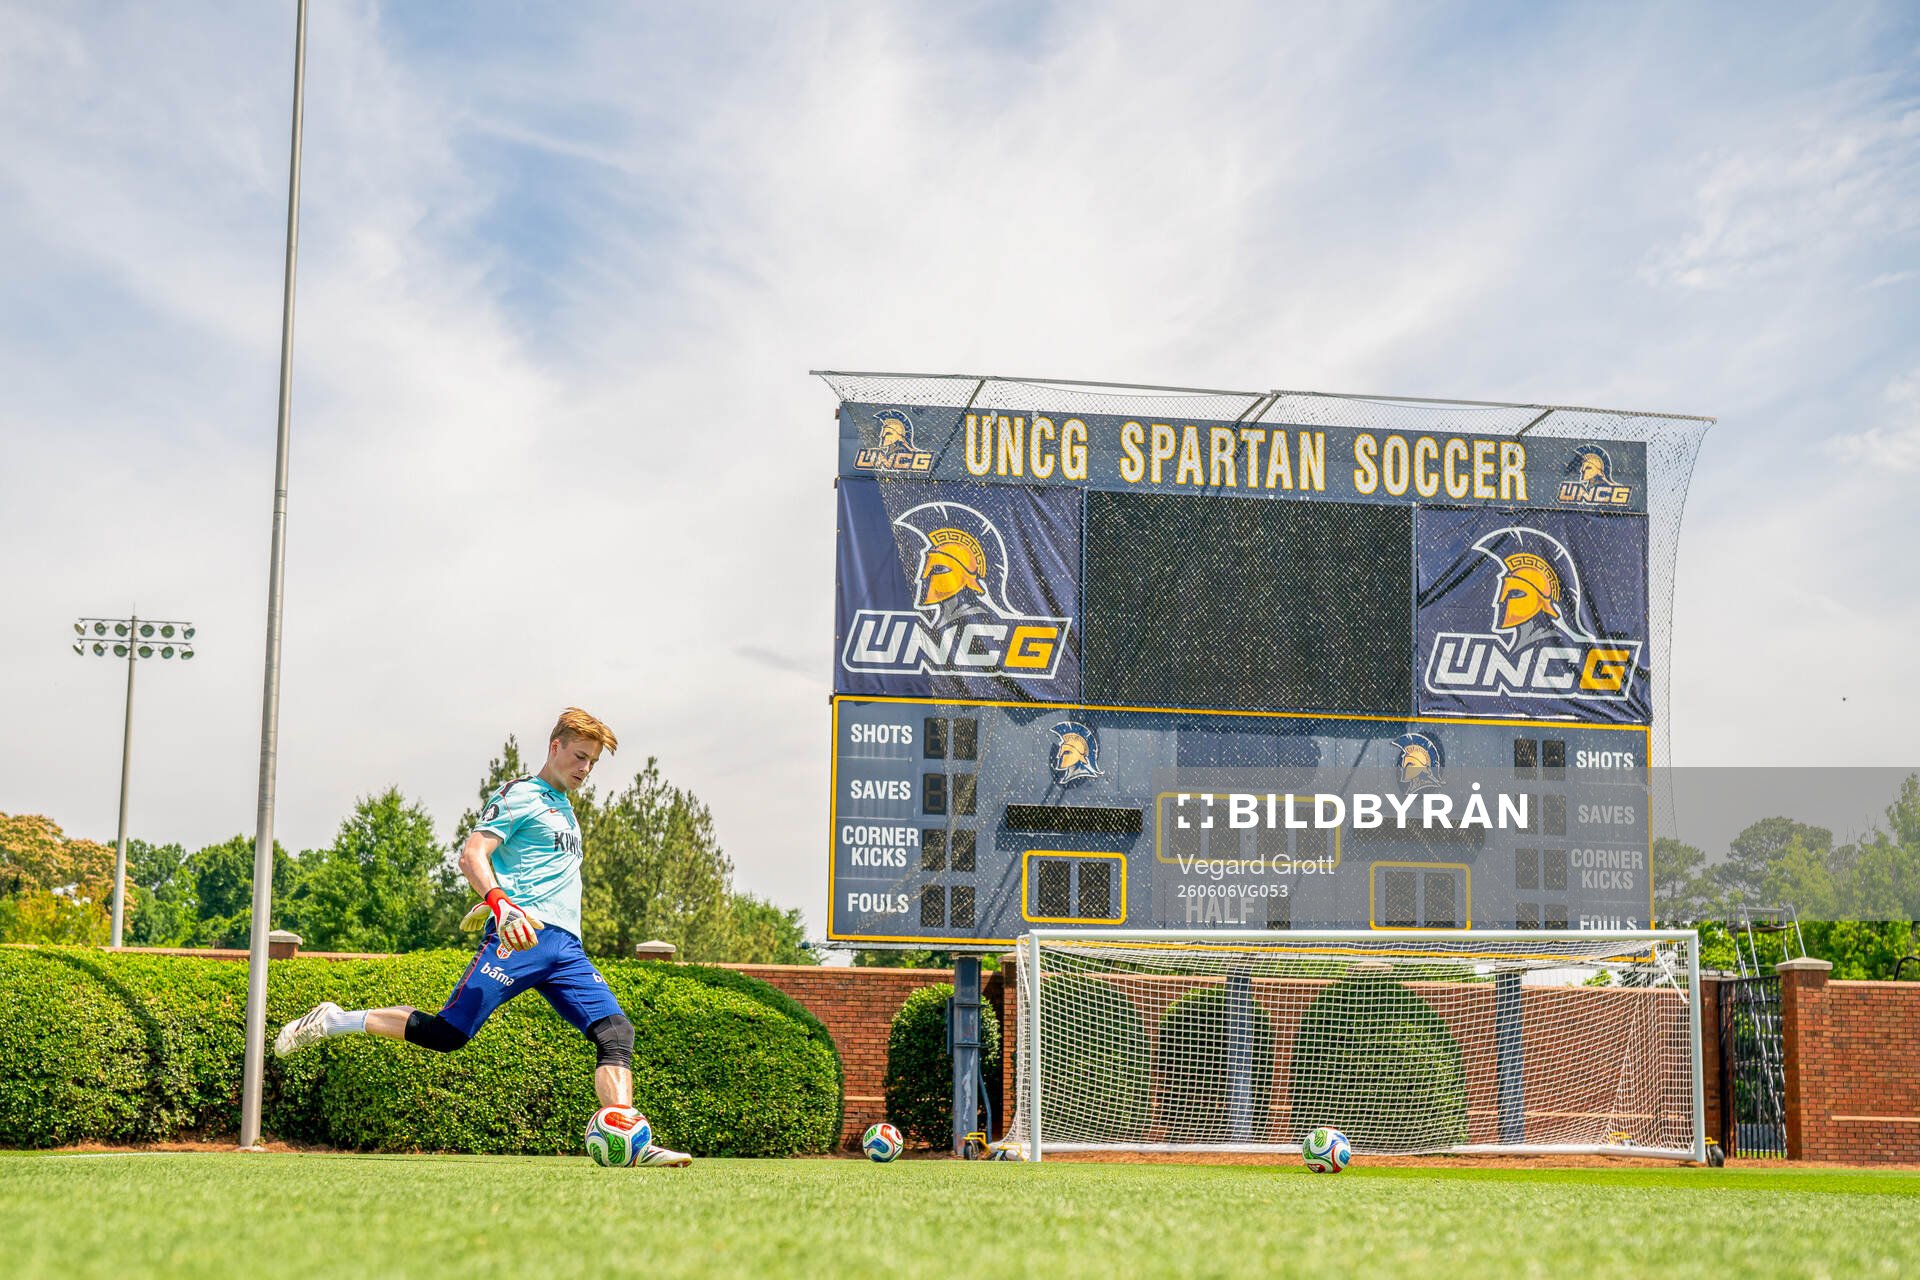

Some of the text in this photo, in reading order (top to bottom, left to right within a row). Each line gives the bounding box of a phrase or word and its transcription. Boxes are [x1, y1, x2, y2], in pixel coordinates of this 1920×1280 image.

[853, 447, 936, 473] UNCG
[964, 414, 1529, 501] UNCG SPARTAN SOCCER
[1557, 483, 1634, 506] UNCG
[852, 614, 1059, 669] UNCG
[1434, 638, 1631, 692] UNCG
[850, 723, 913, 745] SHOTS
[1576, 750, 1635, 771] SHOTS
[850, 779, 912, 800] SAVES
[1578, 804, 1636, 825] SAVES
[842, 825, 919, 848] CORNER
[851, 847, 907, 867] KICKS
[1570, 848, 1644, 870] CORNER
[1581, 870, 1634, 890] KICKS
[847, 892, 910, 914] FOULS
[1185, 896, 1255, 924] HALF
